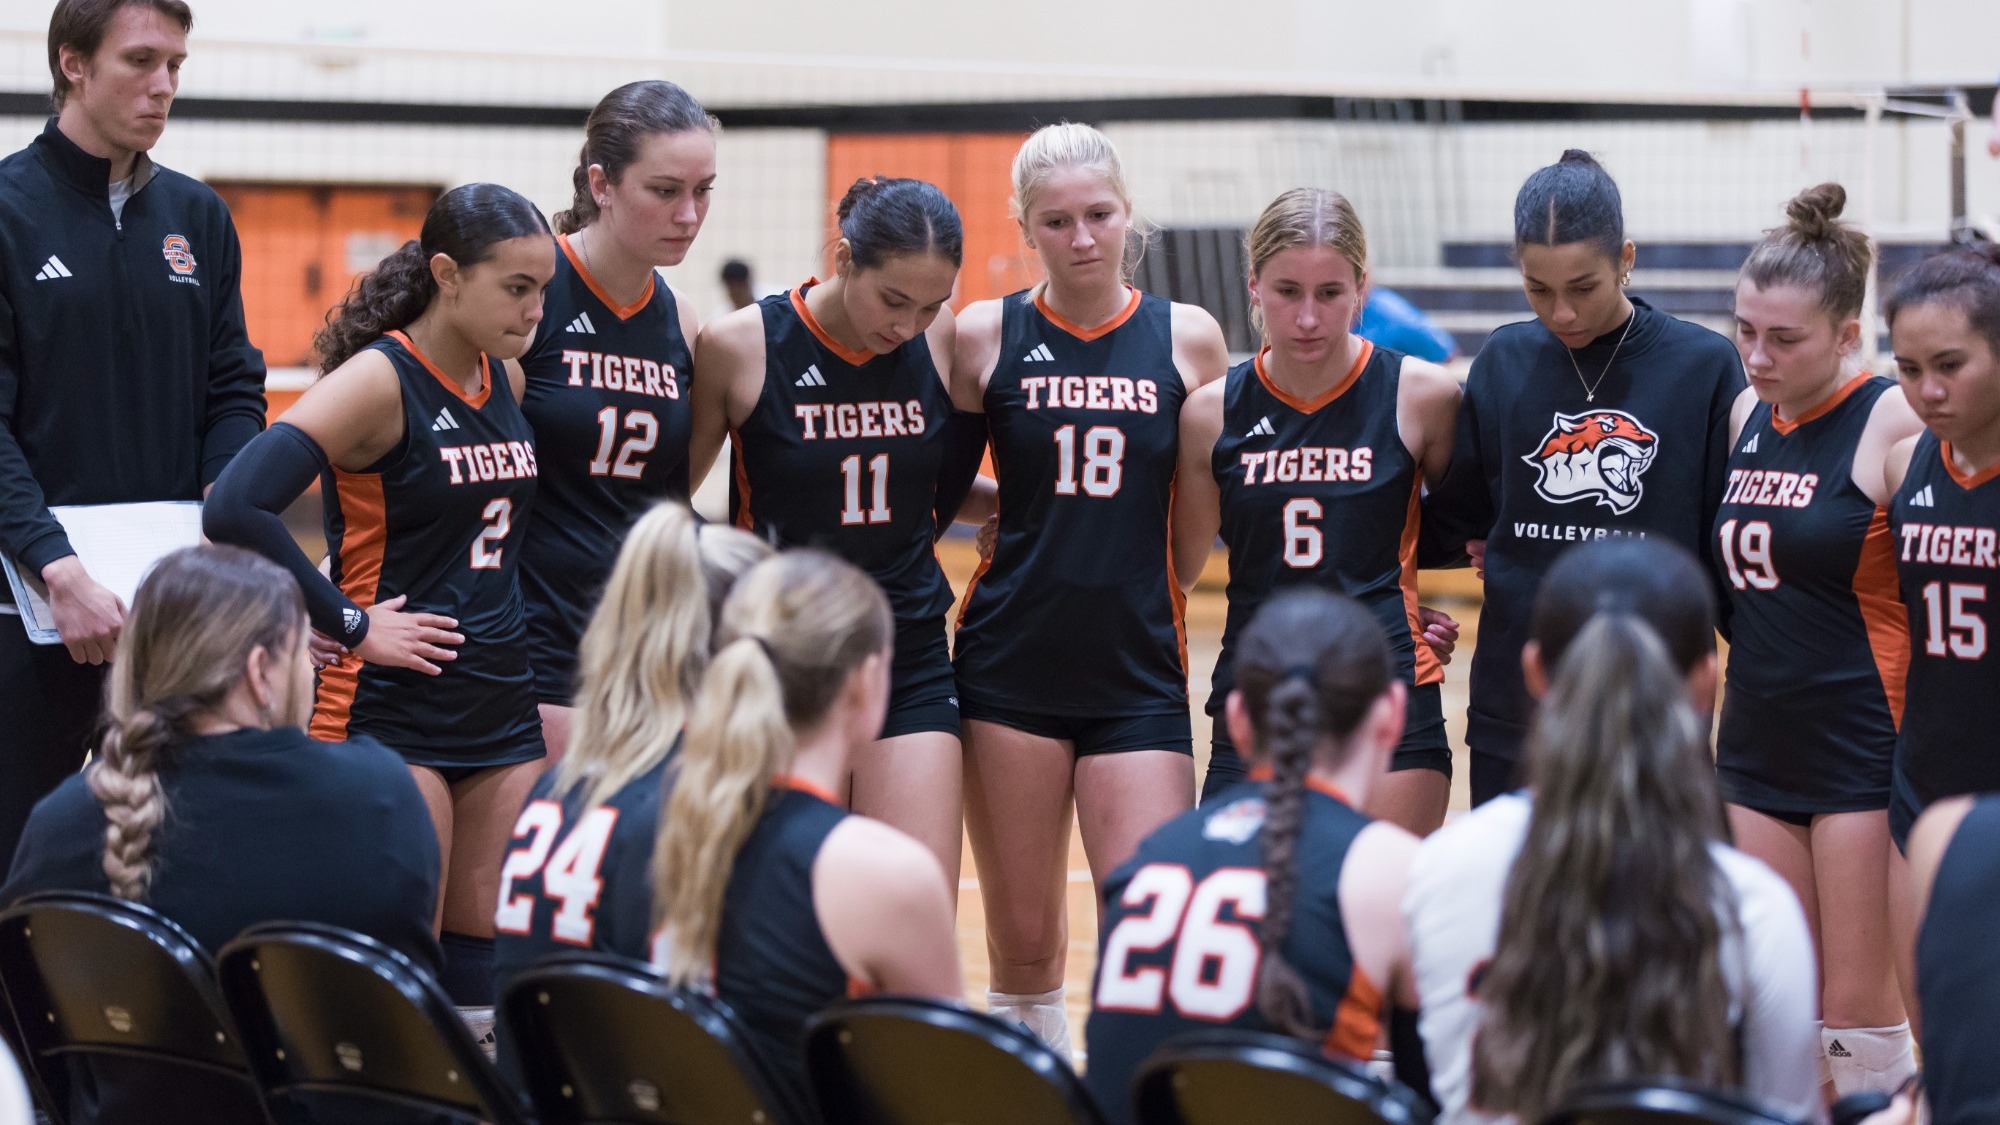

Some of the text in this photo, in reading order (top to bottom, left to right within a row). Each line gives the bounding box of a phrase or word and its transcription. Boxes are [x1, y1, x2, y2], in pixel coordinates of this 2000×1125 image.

[562, 349, 680, 400] TIGERS
[1020, 375, 1159, 415] TIGERS
[589, 406, 660, 480] 12
[795, 400, 926, 441] TIGERS
[439, 439, 538, 486] TIGERS
[840, 453, 892, 526] 11
[1053, 424, 1127, 498] 18
[1240, 446, 1373, 486] TIGERS
[1720, 468, 1819, 509] TIGERS
[469, 497, 514, 571] 2
[1282, 497, 1324, 569] 6
[1718, 518, 1781, 591] 19
[1900, 522, 2000, 568] TIGER
[345, 608, 362, 634] adidas
[1921, 580, 1988, 661] 15
[494, 798, 621, 949] 24
[1096, 862, 1270, 1024] 26
